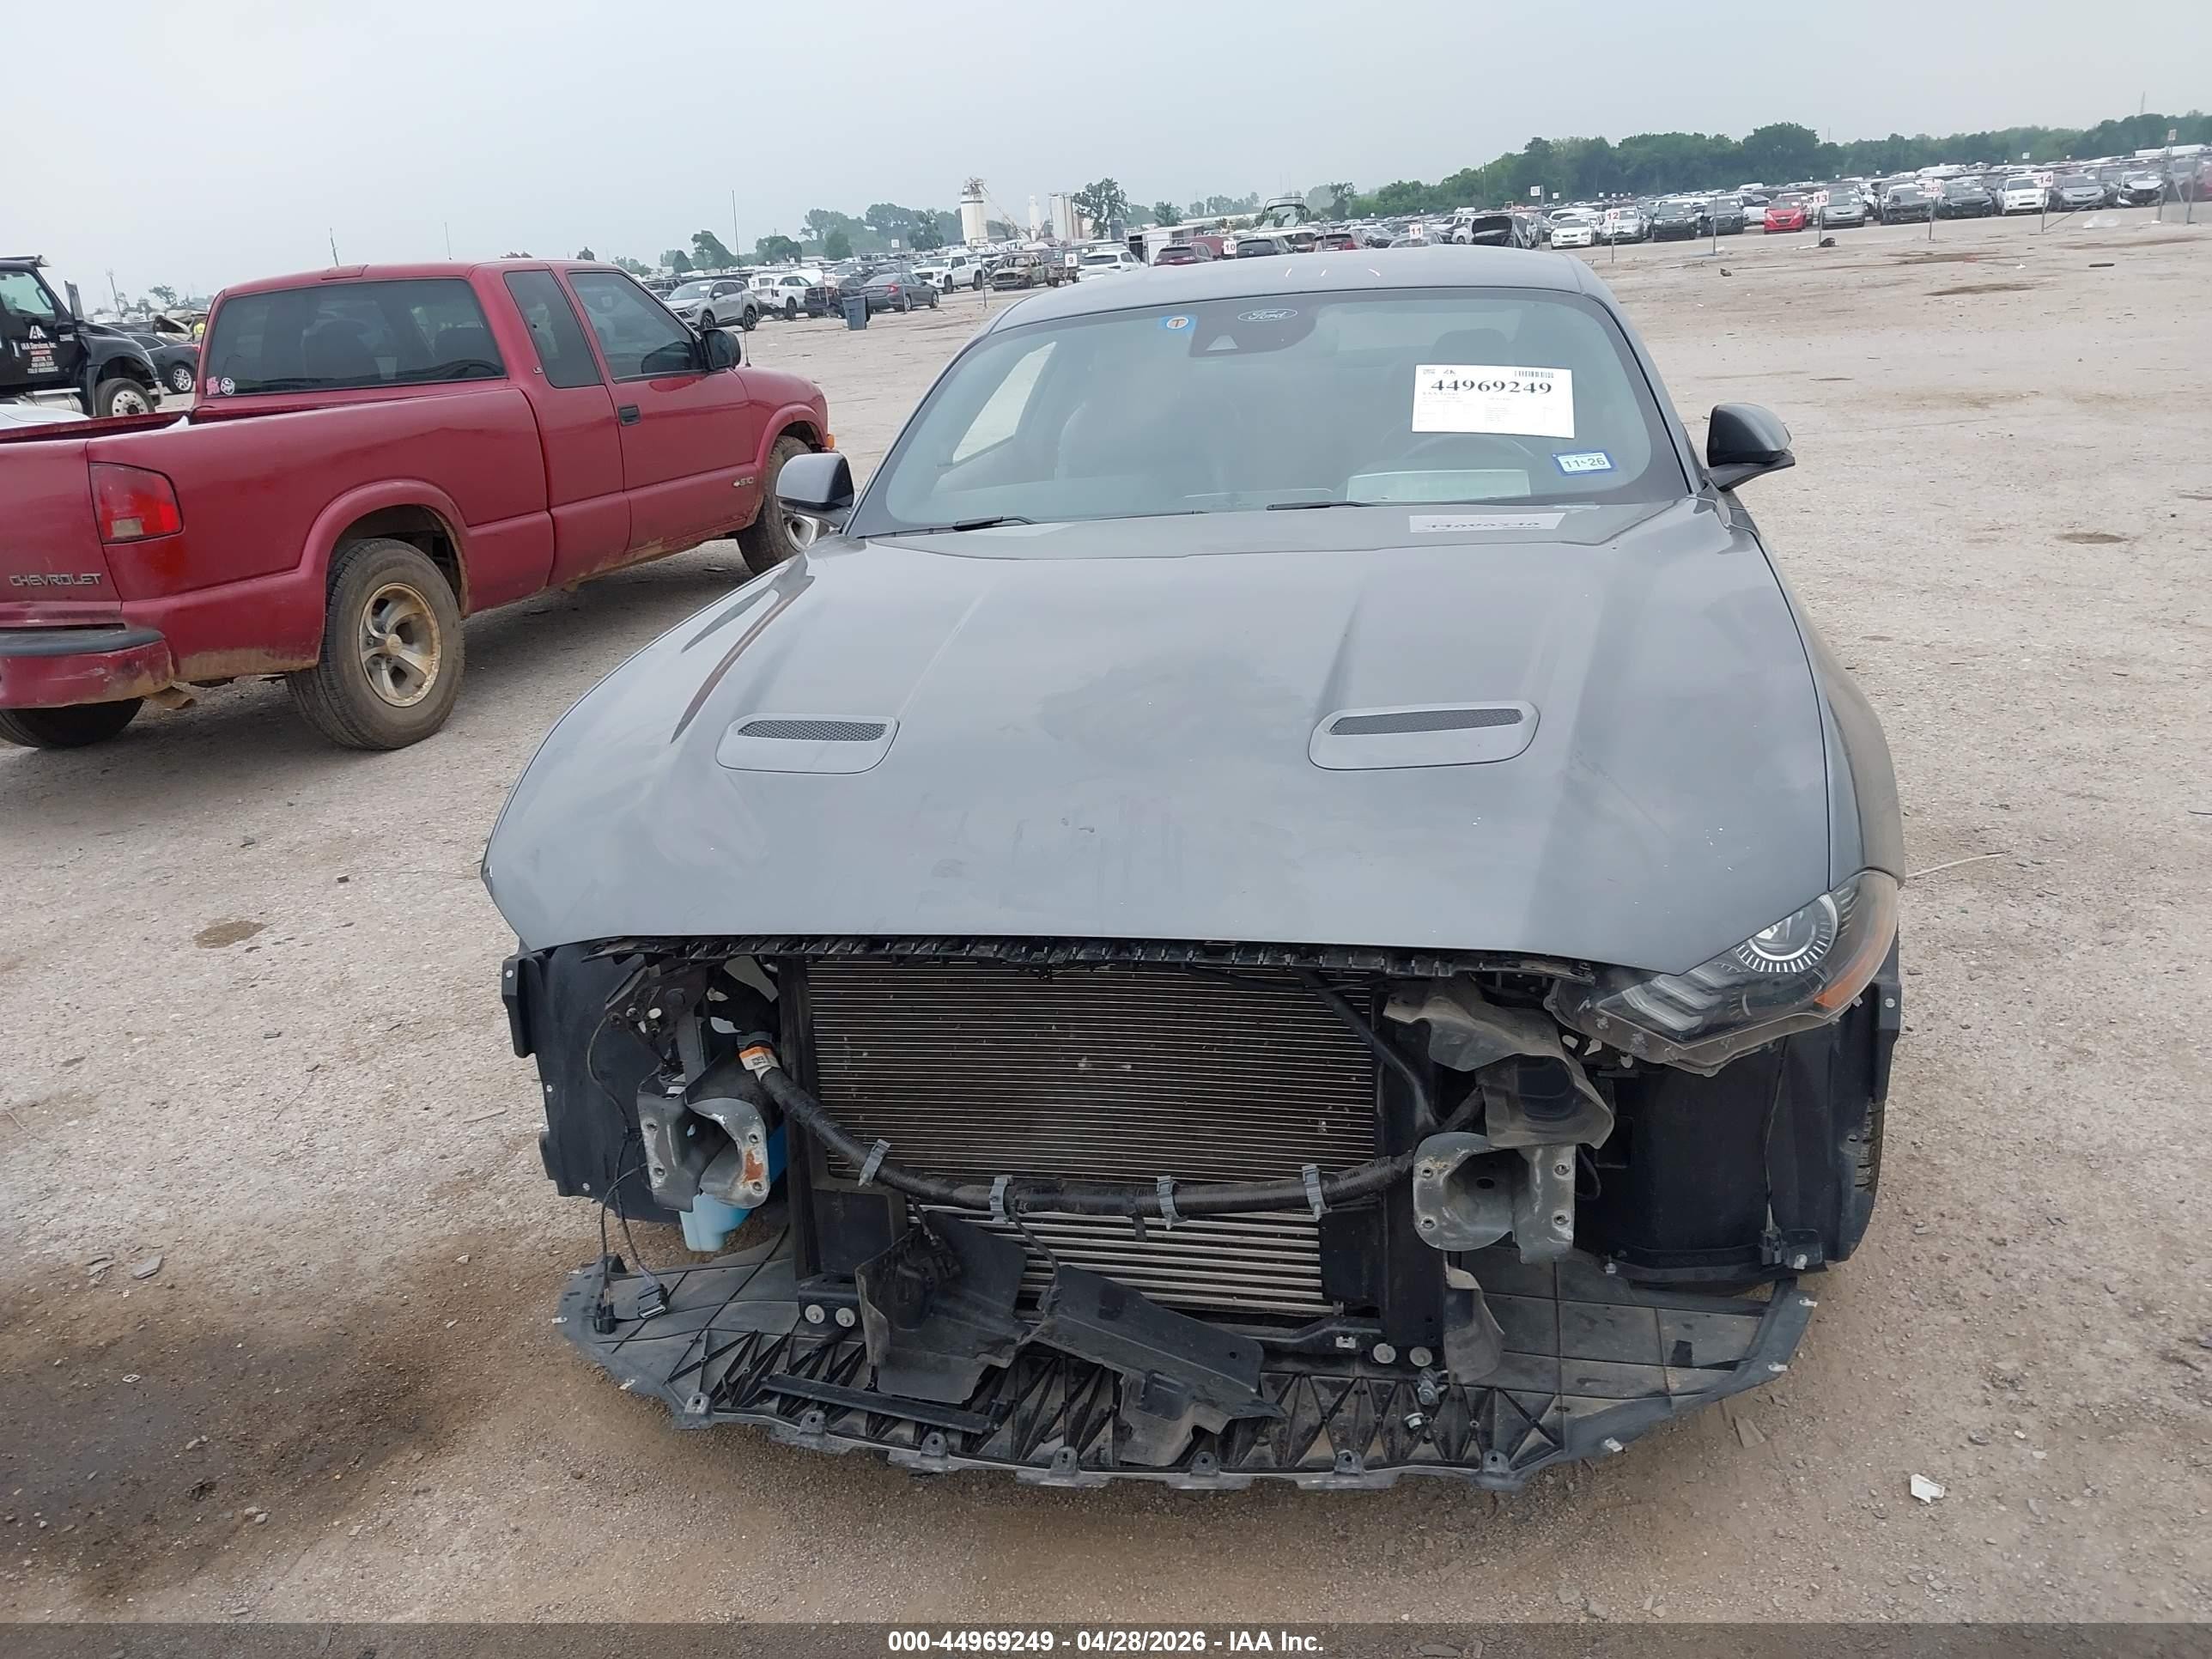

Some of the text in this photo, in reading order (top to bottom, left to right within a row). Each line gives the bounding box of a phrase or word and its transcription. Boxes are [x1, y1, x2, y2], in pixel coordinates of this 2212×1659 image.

[2040, 174, 2052, 184] 14
[1814, 194, 1827, 203] 13
[1607, 211, 1619, 220] 12
[1431, 379, 1553, 395] 44969249
[9, 573, 102, 586] CHEVROLET
